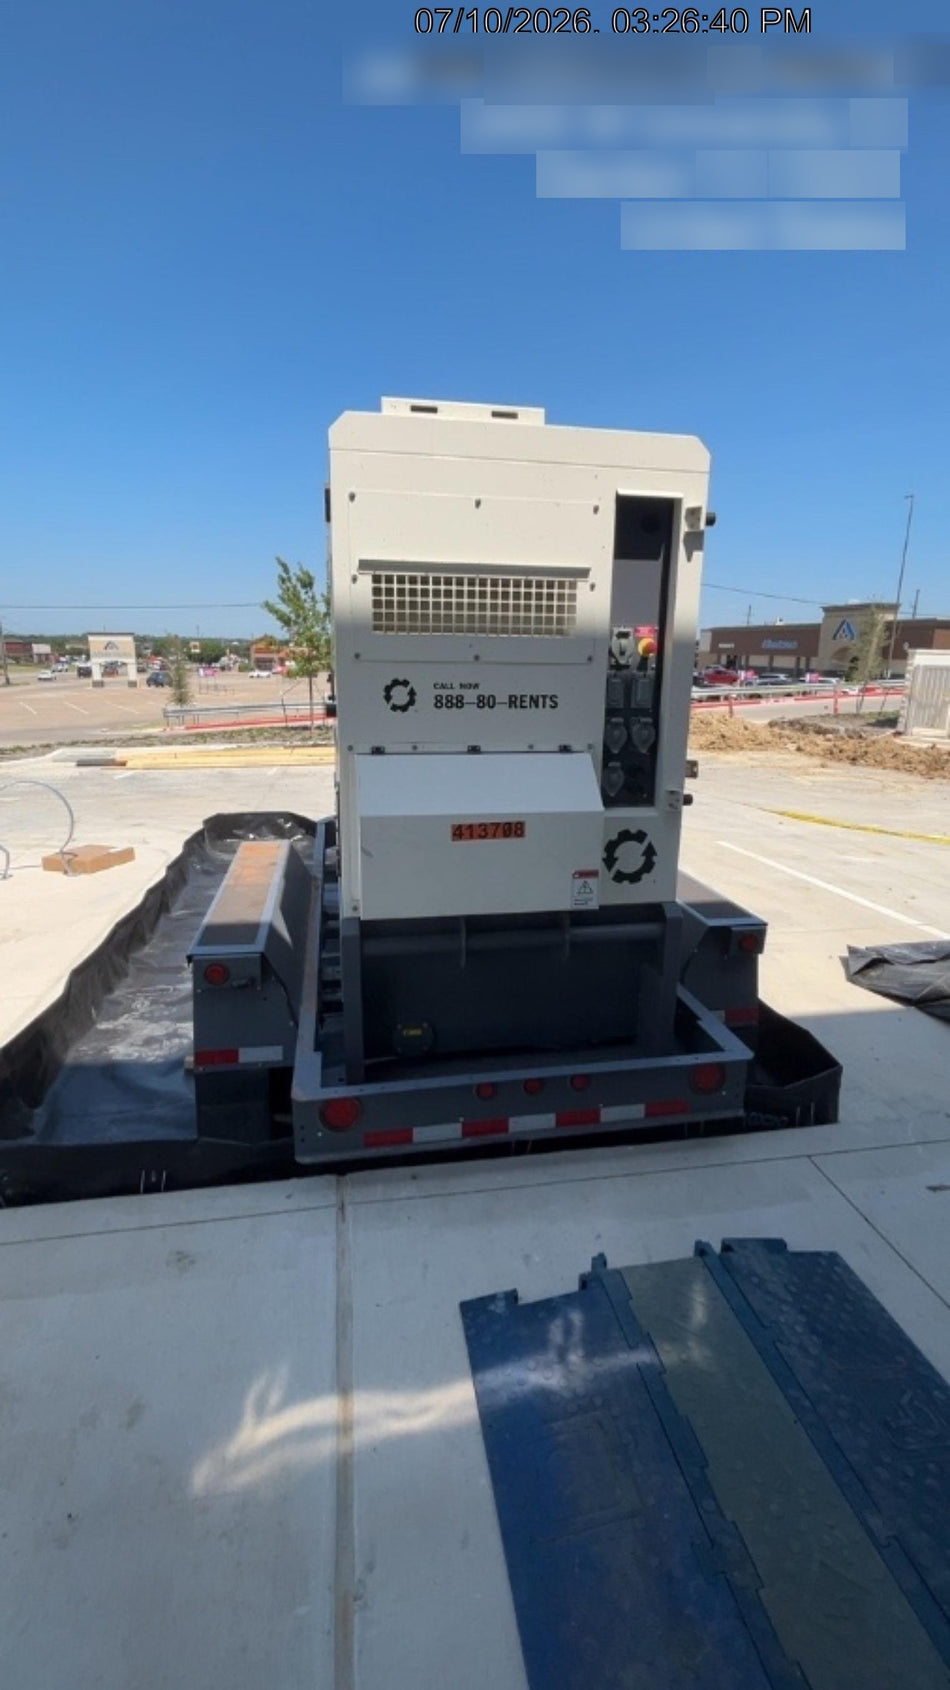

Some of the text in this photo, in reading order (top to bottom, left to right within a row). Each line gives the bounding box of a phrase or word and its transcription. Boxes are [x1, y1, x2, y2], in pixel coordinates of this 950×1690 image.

[433, 682, 480, 690] CALL NOW
[433, 693, 559, 709] 888-80-RENTS
[452, 820, 525, 840] 413708
